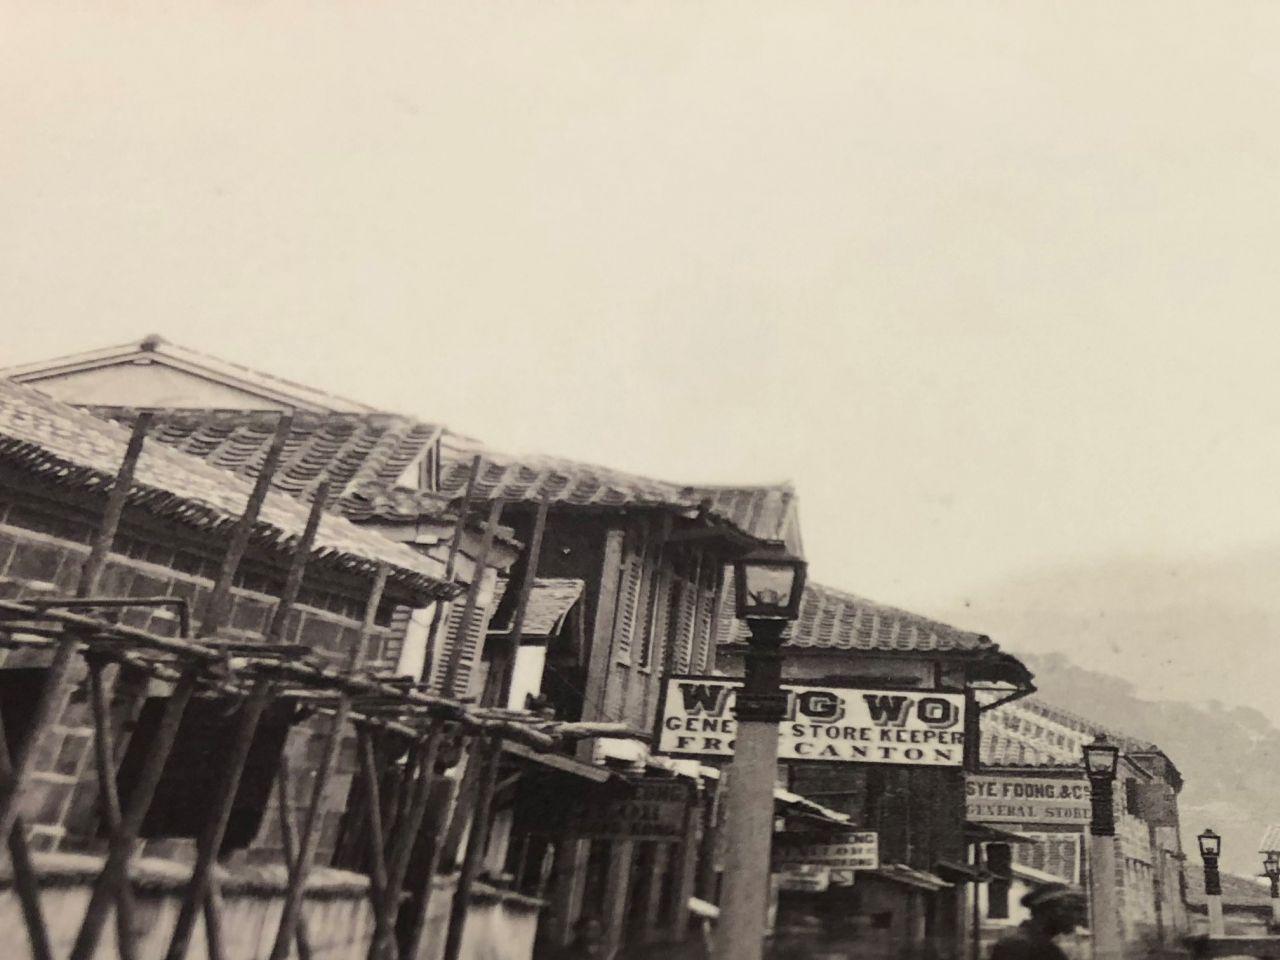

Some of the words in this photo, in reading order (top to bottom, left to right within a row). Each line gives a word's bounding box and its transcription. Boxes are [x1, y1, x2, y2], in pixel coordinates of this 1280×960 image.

[863, 694, 960, 729] WO
[792, 724, 872, 741] STORE
[967, 781, 997, 796] SYE
